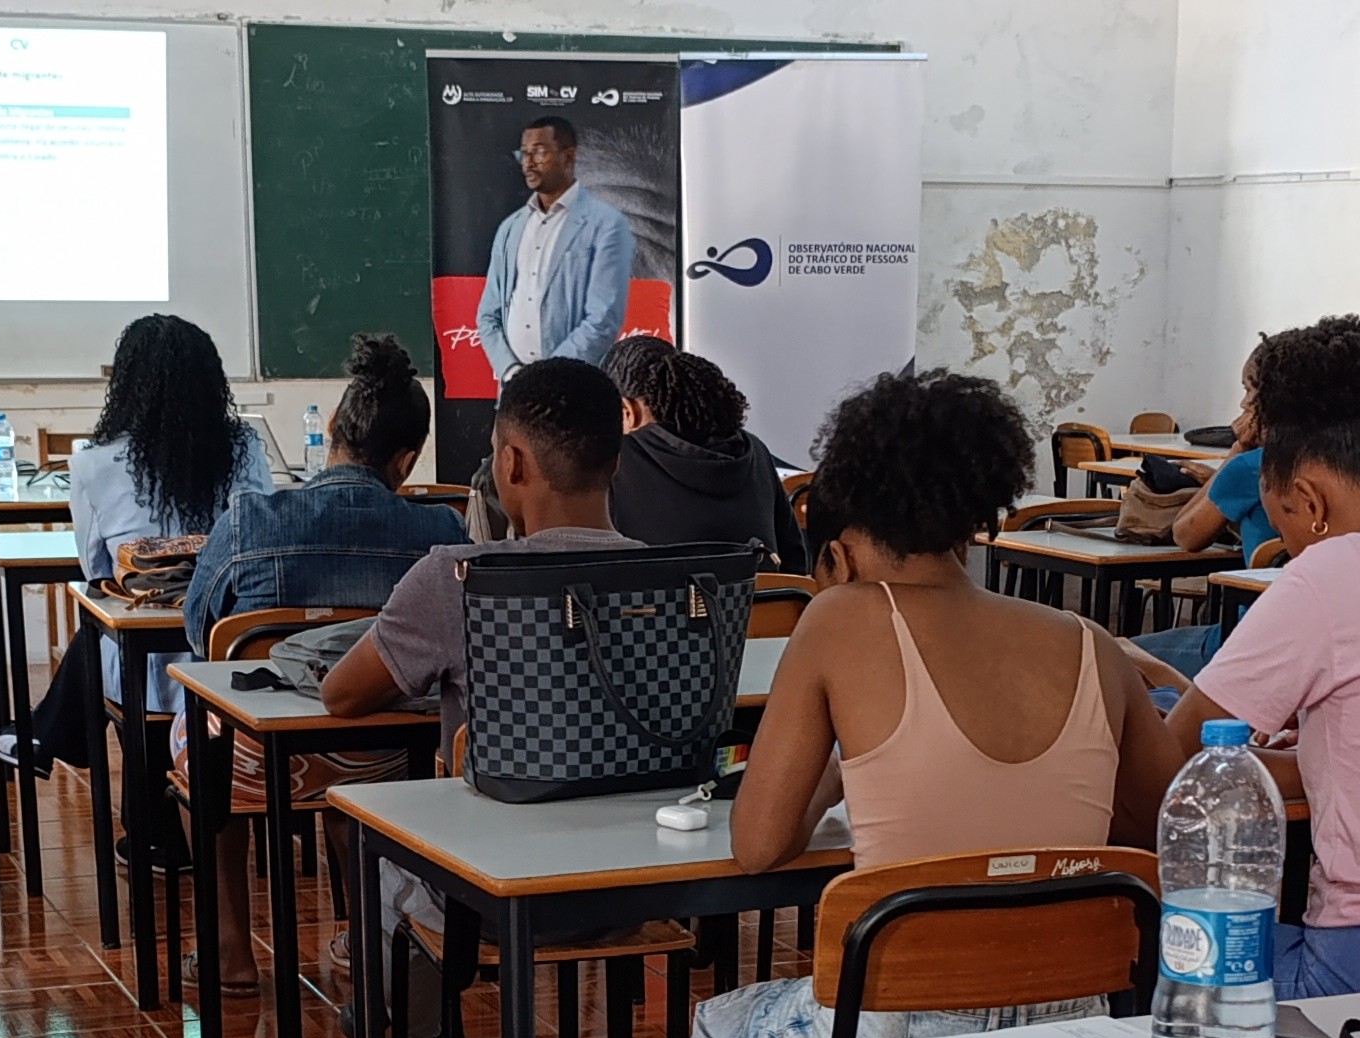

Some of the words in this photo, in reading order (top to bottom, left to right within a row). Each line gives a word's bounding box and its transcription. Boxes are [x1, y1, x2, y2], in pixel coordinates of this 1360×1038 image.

[527, 85, 549, 97] SIM
[559, 86, 578, 98] CV
[788, 242, 864, 253] OBSERVATÓRIO
[866, 243, 916, 254] NACIONAL
[788, 254, 803, 264] DO
[804, 252, 847, 264] TRÁFICO
[850, 254, 863, 264] DE
[865, 254, 909, 264] PESSOAS
[788, 265, 802, 275] DE
[804, 265, 832, 275] CABO
[833, 265, 865, 275] VERDE
